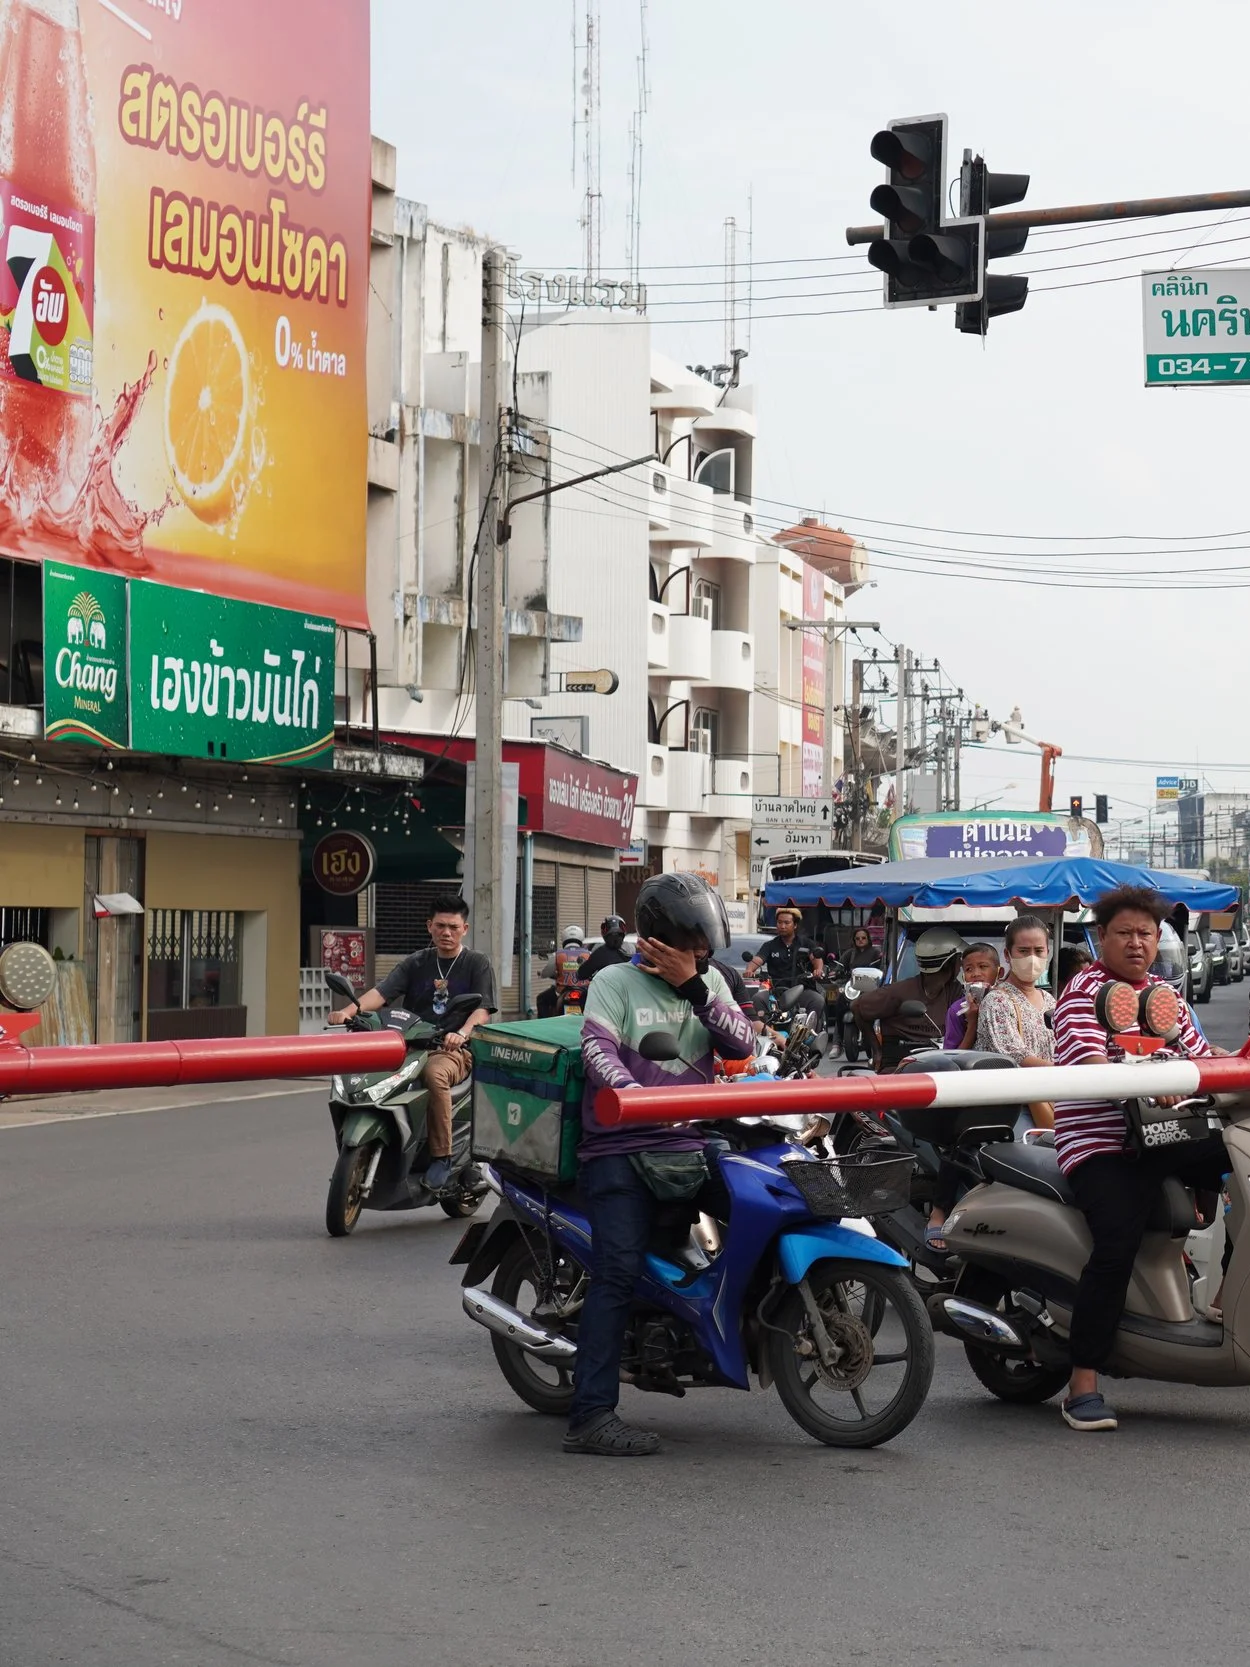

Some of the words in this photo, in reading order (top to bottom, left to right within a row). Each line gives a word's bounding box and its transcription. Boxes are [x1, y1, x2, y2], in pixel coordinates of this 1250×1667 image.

[150, 194, 348, 302] เลมอนโซดา
[36, 278, 65, 324] อัพ
[1152, 276, 1209, 297] คลินิก
[306, 330, 346, 377] น้ำตาล
[55, 647, 118, 704] Chang
[150, 639, 320, 730] เฮงข้าวมันไก่
[755, 798, 816, 817] บ้านลาดใหญ่
[785, 831, 822, 845] อัมพวา
[321, 849, 361, 876] เฮง
[1141, 1120, 1180, 1136] HOUSE
